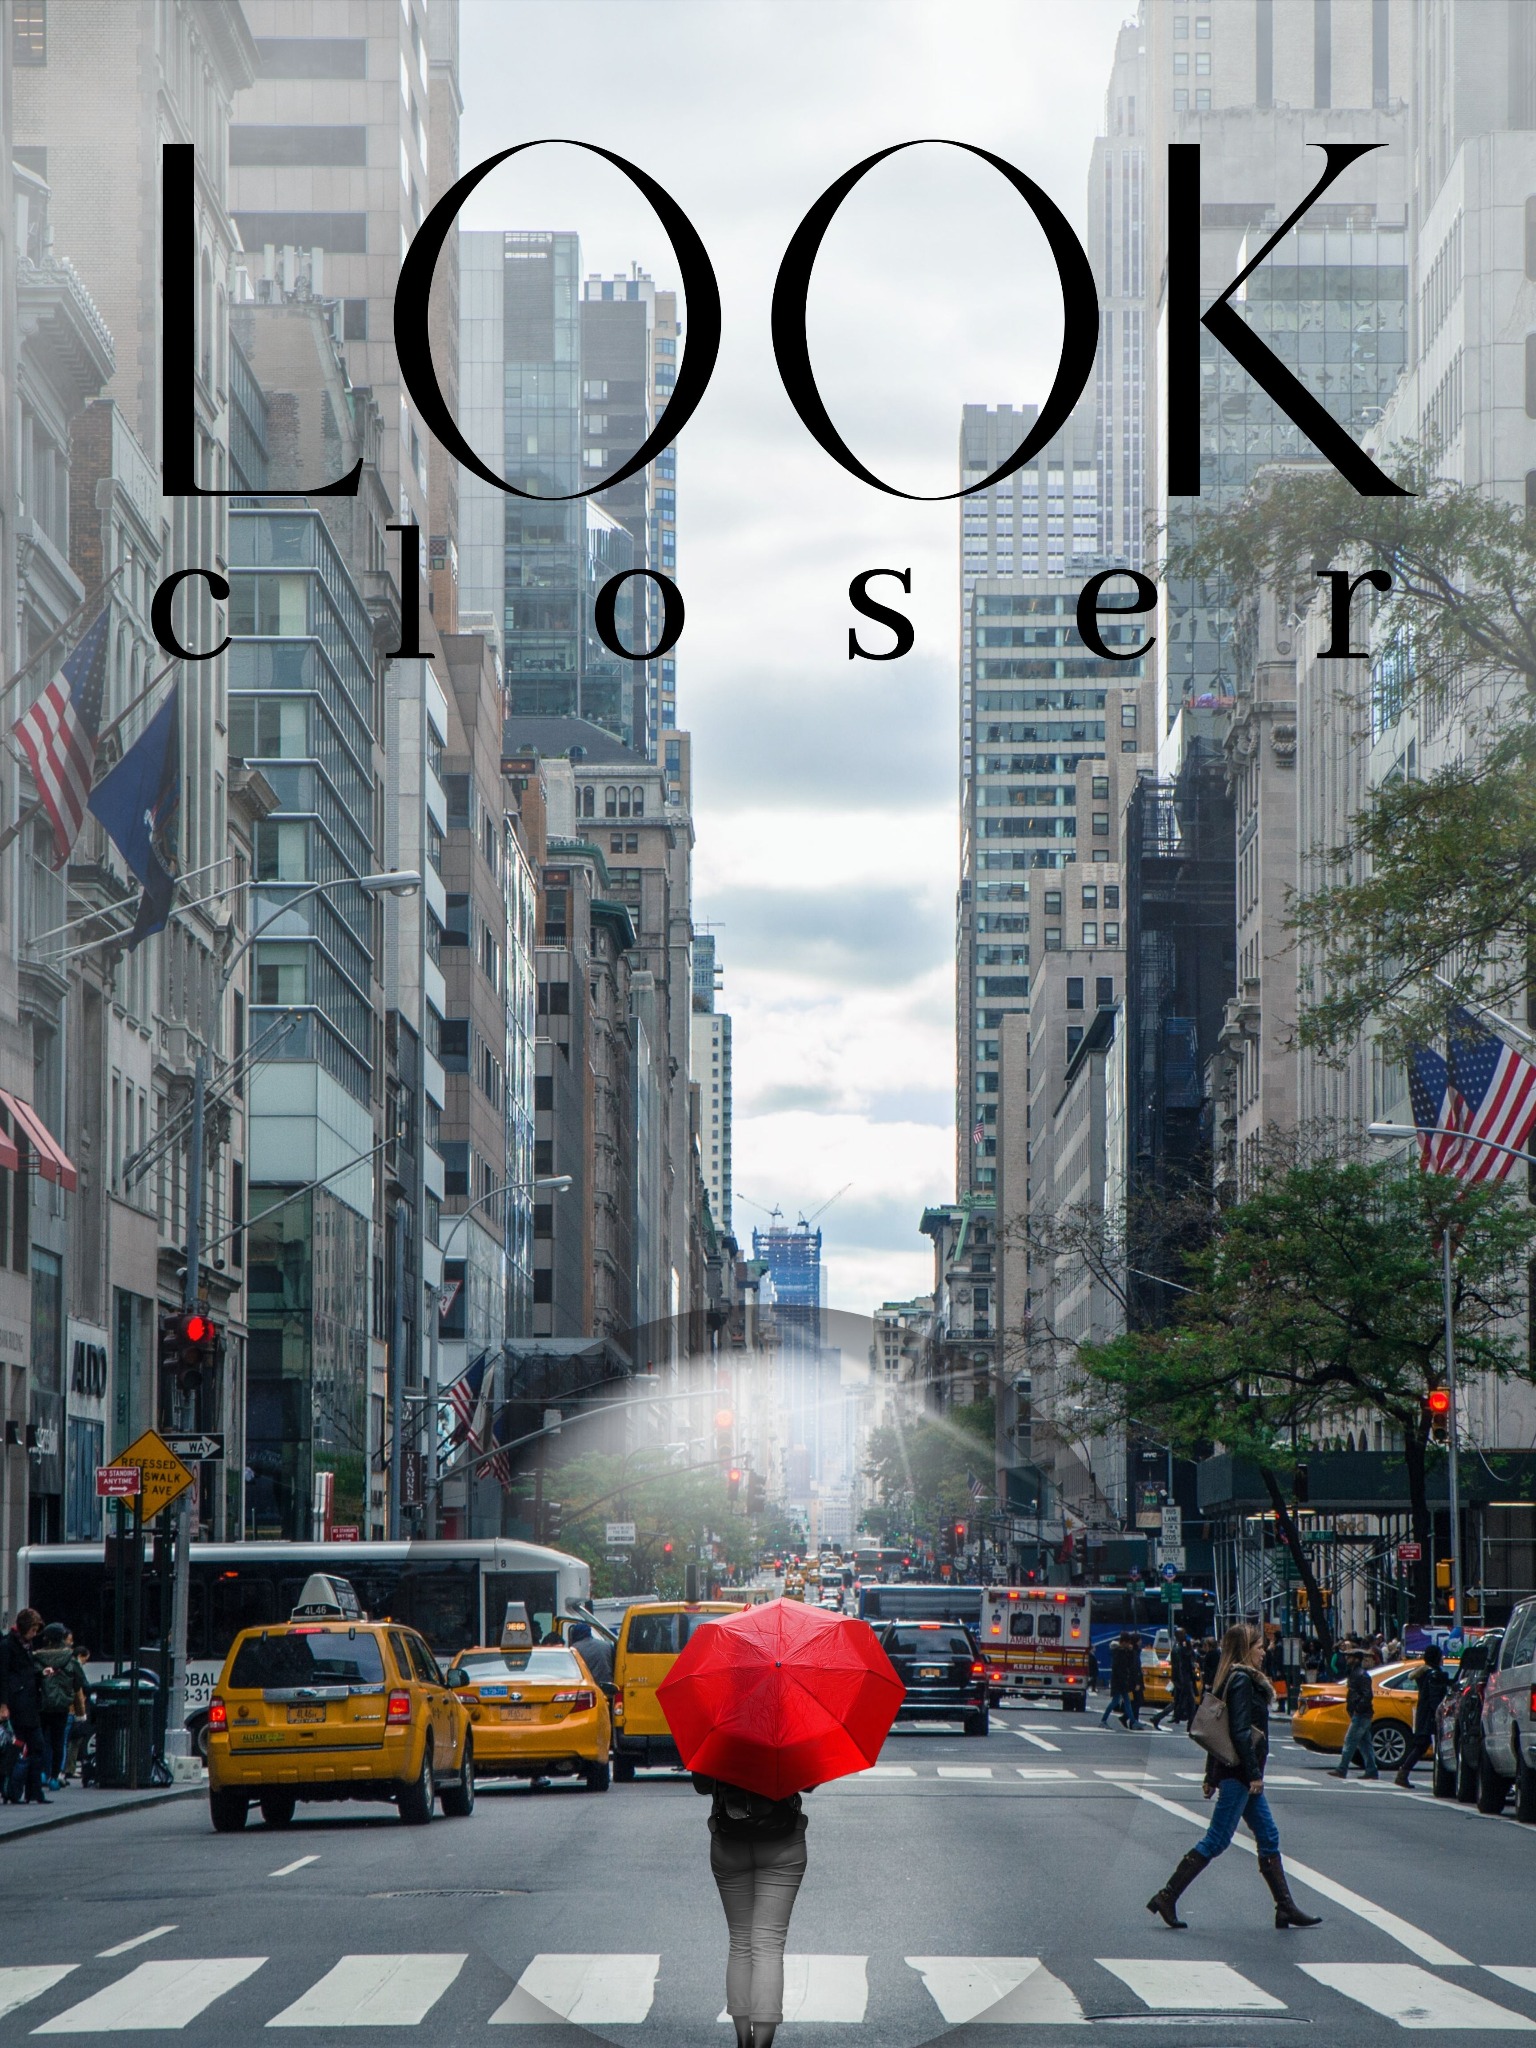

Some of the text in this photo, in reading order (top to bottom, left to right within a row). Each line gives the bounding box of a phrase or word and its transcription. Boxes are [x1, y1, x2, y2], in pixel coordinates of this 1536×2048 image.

[71, 1340, 107, 1399] ALDO
[189, 1442, 212, 1453] WAY
[121, 1458, 177, 1470] RECESSED
[109, 1469, 137, 1477] STANDING
[144, 1472, 181, 1483] SWALK
[152, 1485, 172, 1496] AVE
[501, 1560, 507, 1569] 8
[305, 1606, 327, 1615] 4L46
